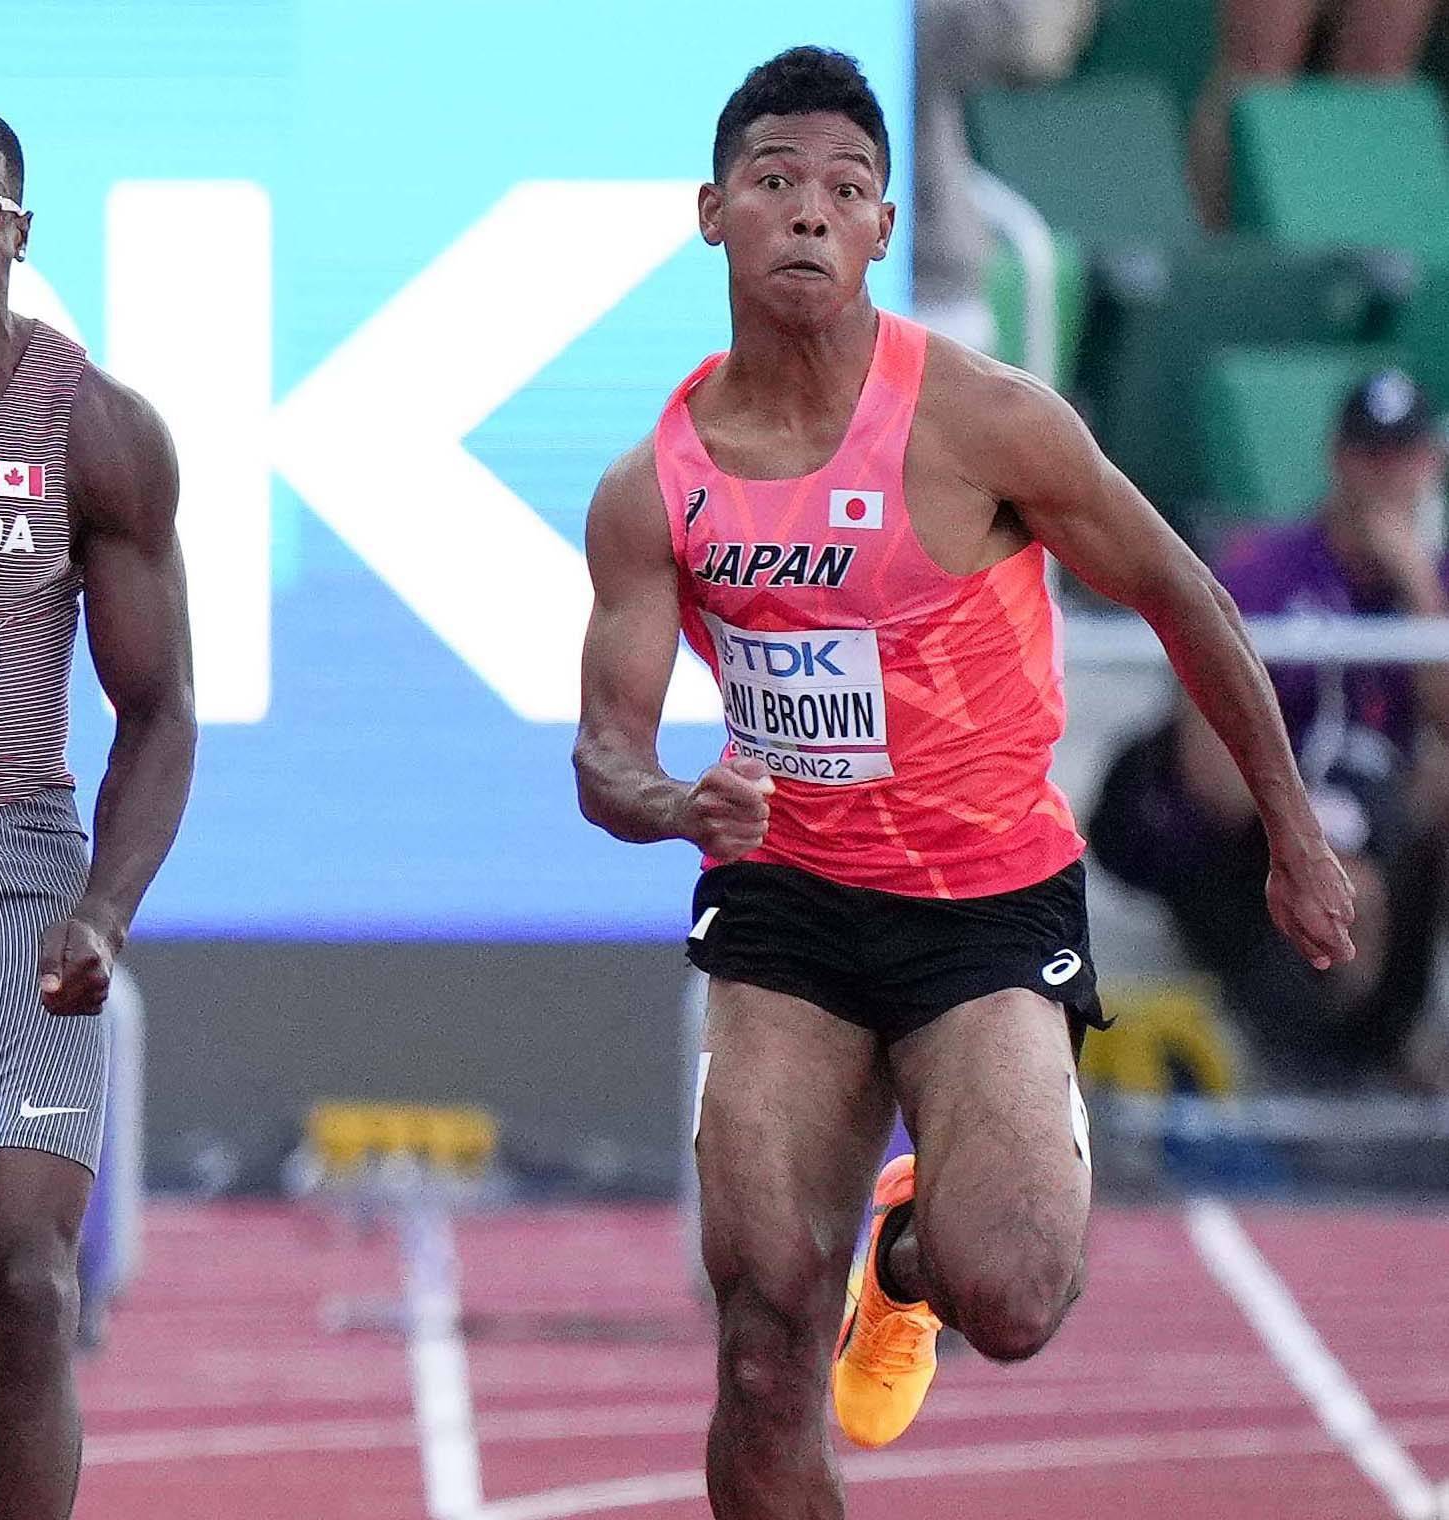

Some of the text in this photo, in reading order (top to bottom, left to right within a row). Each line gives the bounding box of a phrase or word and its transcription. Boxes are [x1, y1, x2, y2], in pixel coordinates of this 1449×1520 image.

[694, 543, 857, 588] JAPAN
[730, 634, 846, 678] TDK
[762, 689, 875, 740] BROWN
